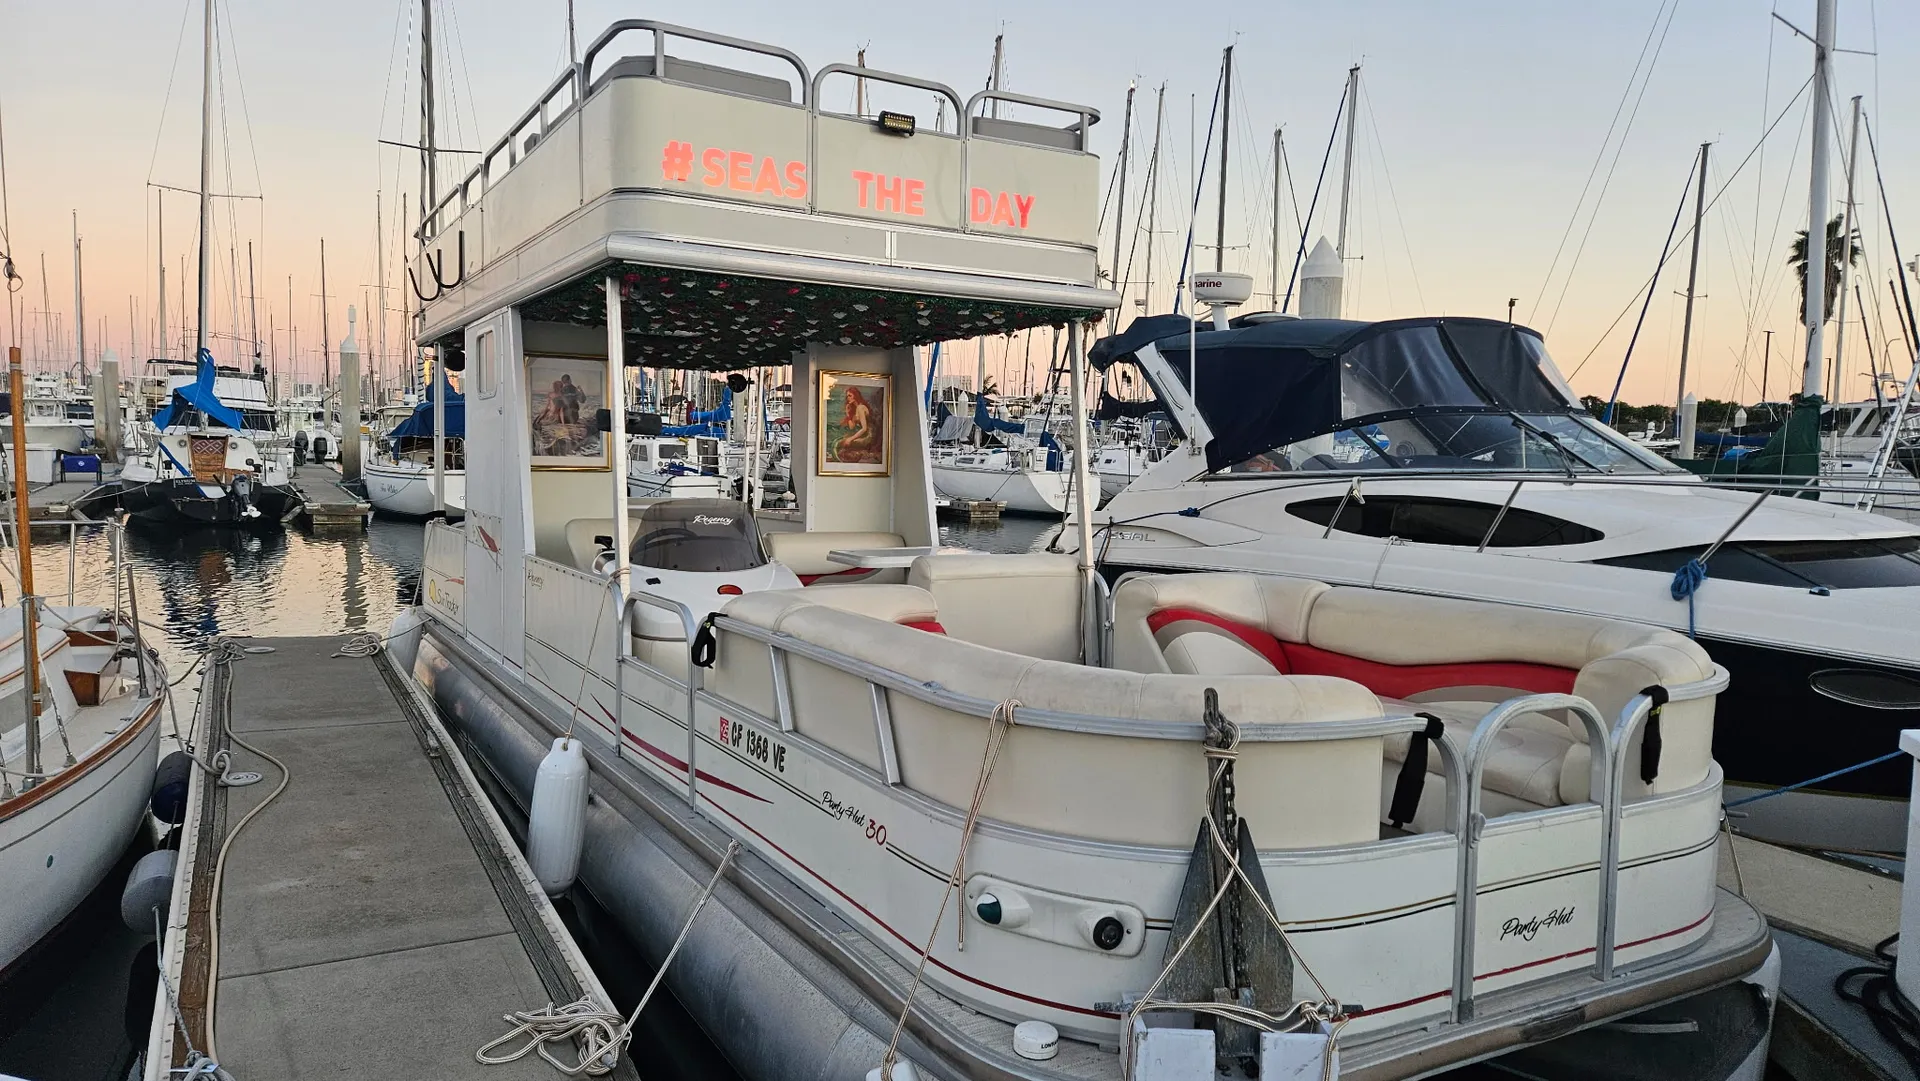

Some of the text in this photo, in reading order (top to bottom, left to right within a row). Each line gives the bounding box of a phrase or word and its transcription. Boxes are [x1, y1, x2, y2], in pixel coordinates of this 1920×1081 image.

[852, 170, 925, 216] THE
[970, 187, 1036, 228] DAY
[692, 514, 734, 526] Regency
[731, 721, 786, 773] CF 1368 VE
[821, 790, 887, 846] Party Hut 30
[1500, 906, 1576, 942] Party Hut
